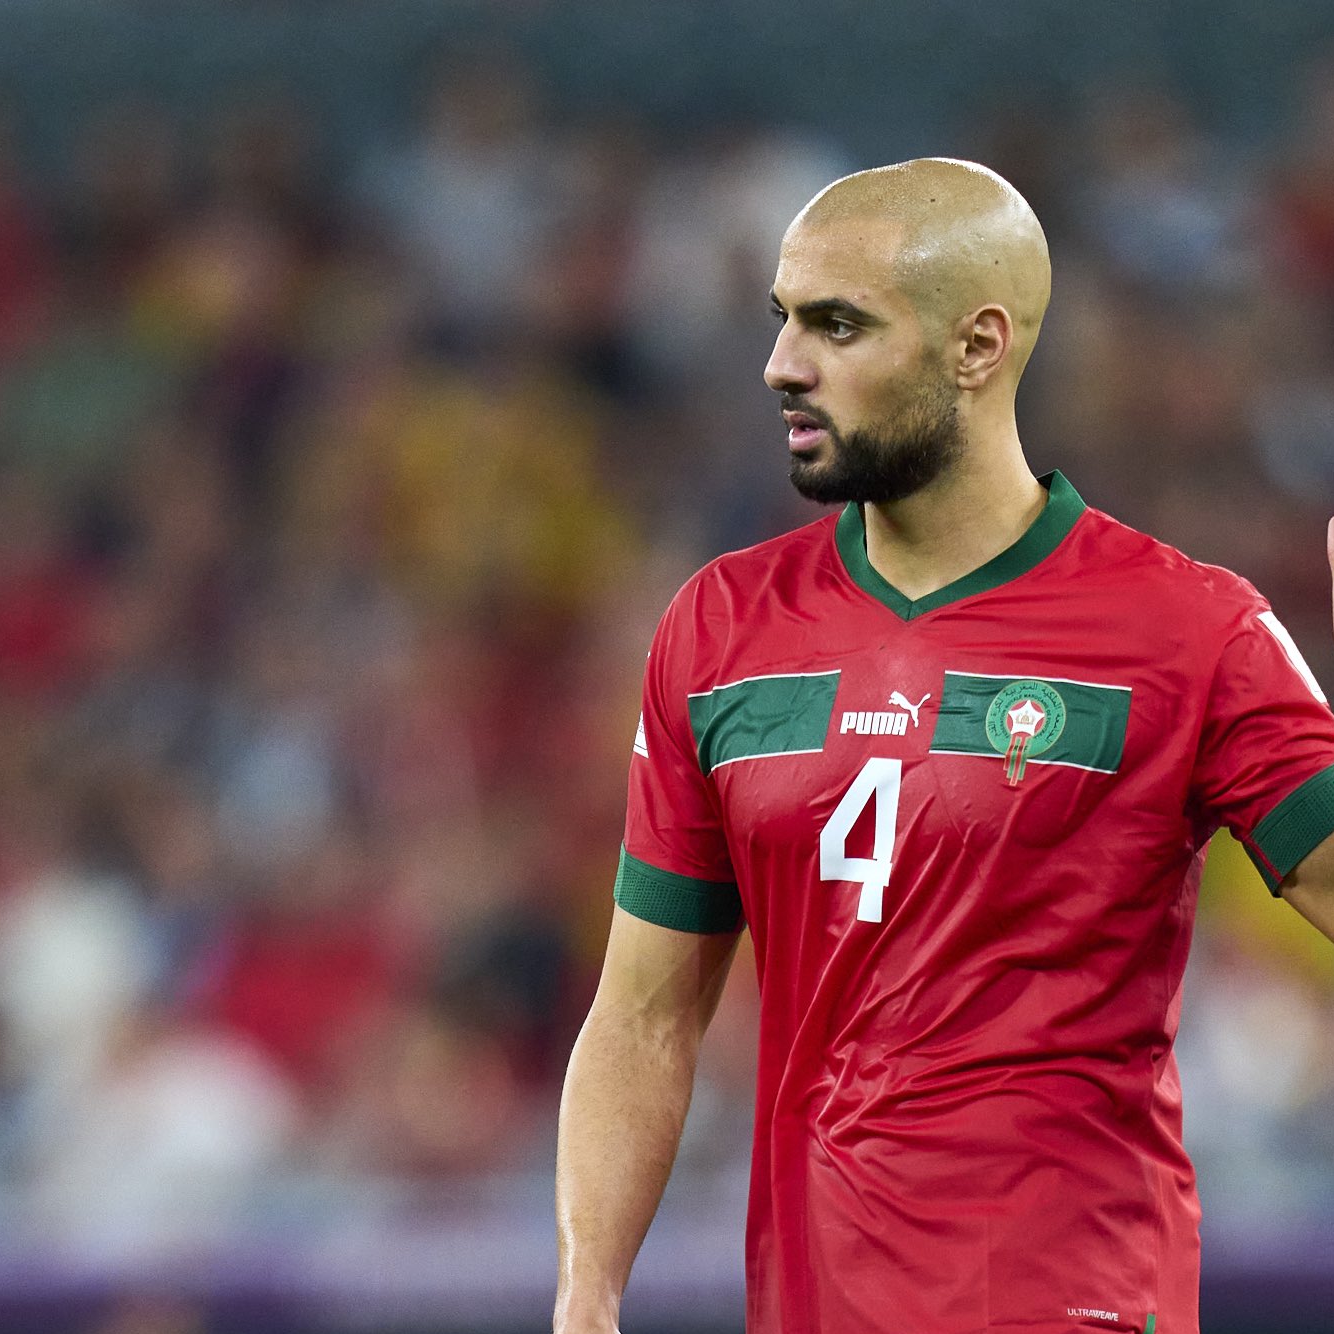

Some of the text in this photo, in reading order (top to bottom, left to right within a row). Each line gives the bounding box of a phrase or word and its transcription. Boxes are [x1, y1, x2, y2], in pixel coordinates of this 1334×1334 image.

[840, 711, 909, 736] PUMA
[819, 757, 903, 923] 4
[1067, 1307, 1119, 1322] ULTRAWEAVE
